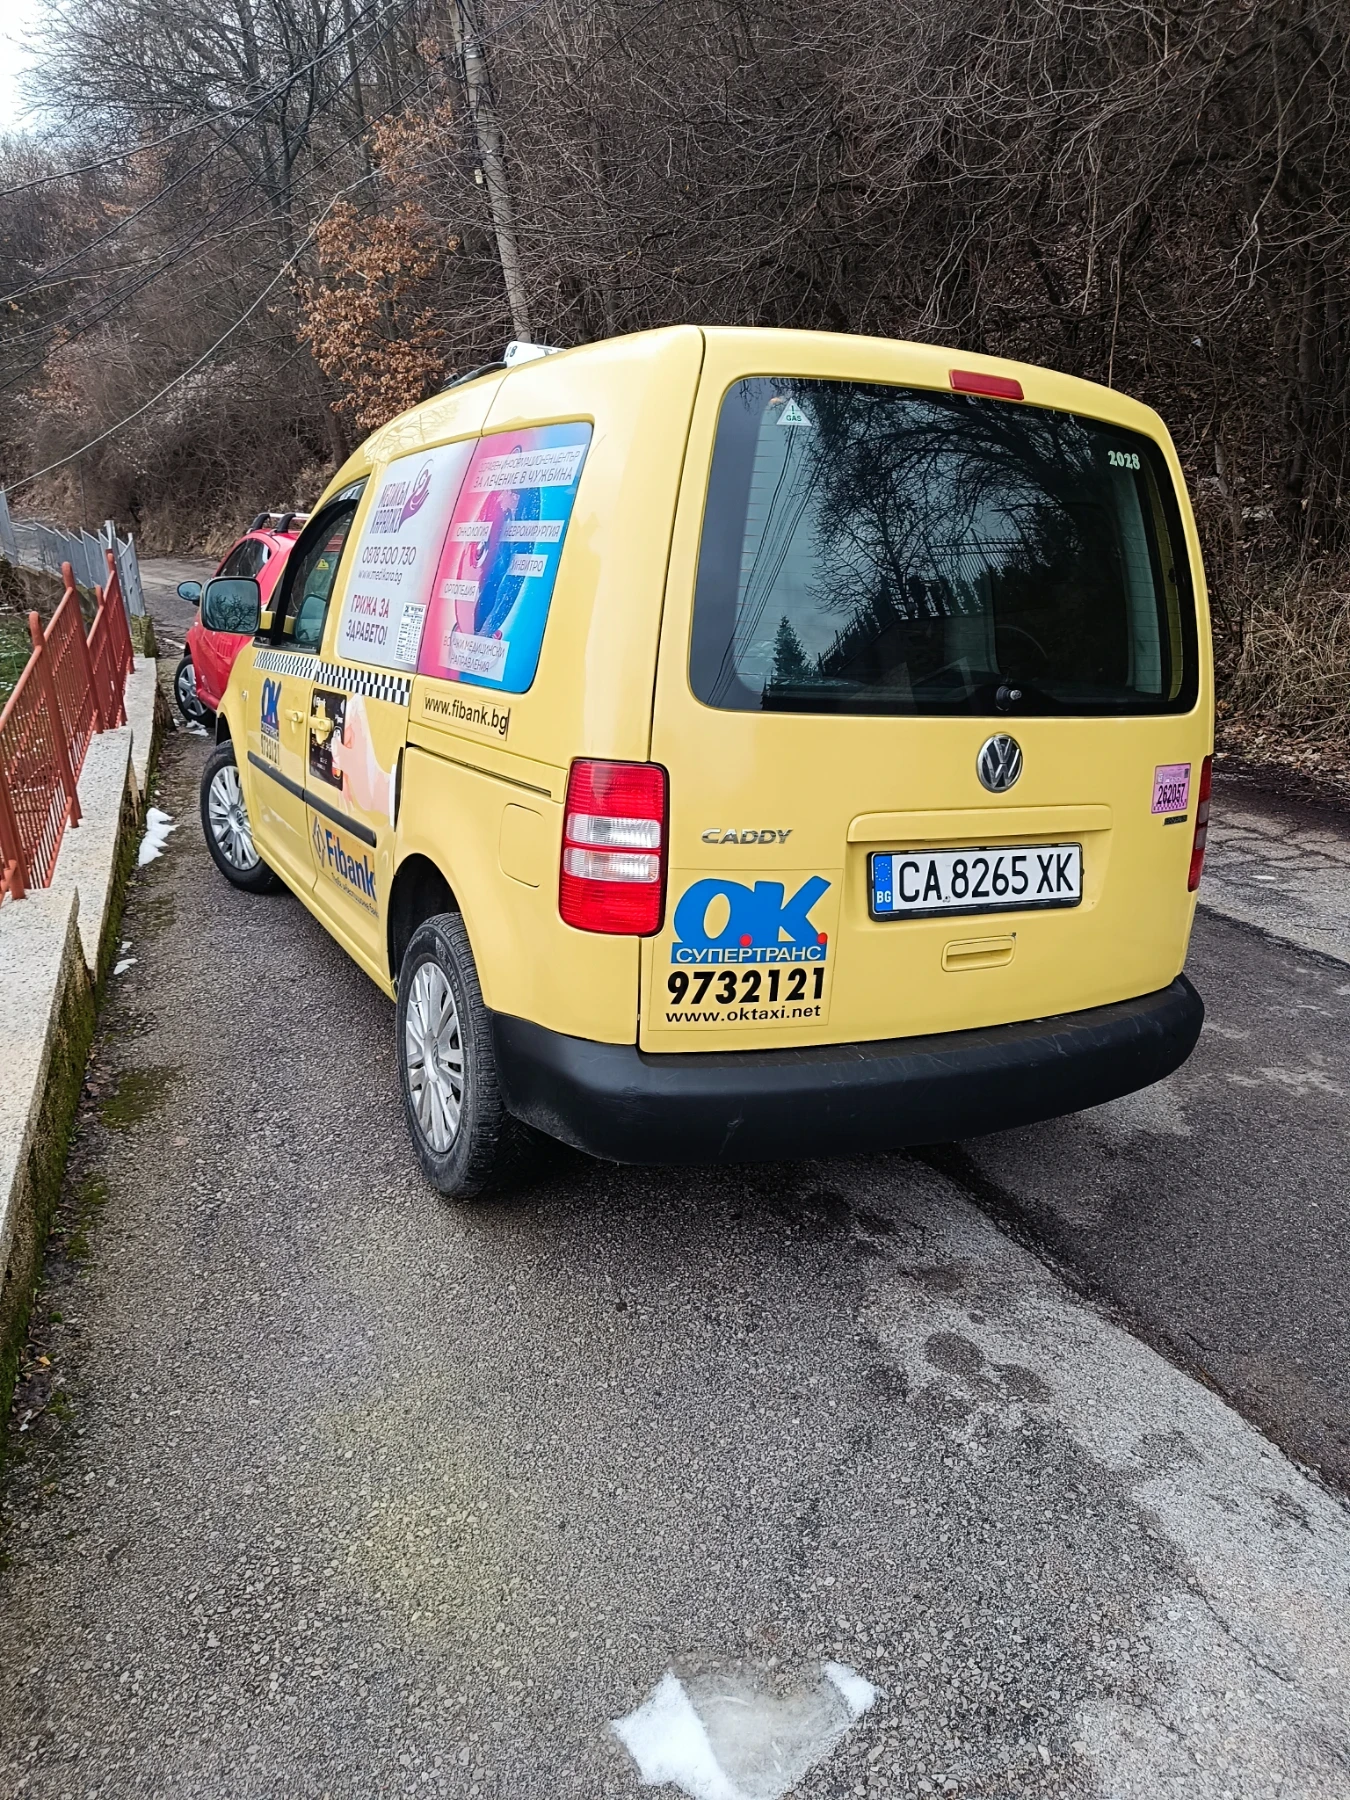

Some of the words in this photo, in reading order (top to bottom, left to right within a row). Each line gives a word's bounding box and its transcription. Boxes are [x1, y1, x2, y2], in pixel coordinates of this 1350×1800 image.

[786, 414, 802, 422] GAS
[1107, 450, 1141, 470] 2028
[473, 476, 482, 488] ЗА
[483, 472, 520, 487] ЛЕЧЕНИЕ
[519, 471, 527, 484] В
[528, 467, 574, 484] ЧУЖБИНА
[504, 525, 561, 537] НЕВРОХИРУРГИЯ
[380, 546, 399, 565] 500
[398, 547, 417, 565] 730
[511, 560, 544, 572] ИНВИТРО
[444, 583, 476, 596] ОРТОПЕДИЯ
[351, 594, 378, 617] ГРИЖА
[379, 598, 390, 618] ЗА
[346, 619, 388, 646] ЗДРАВЕТО!
[424, 696, 509, 735] www.fibank.bg
[1156, 782, 1186, 805] 262057
[701, 828, 793, 844] CADDY
[325, 828, 378, 903] Fibank
[899, 860, 943, 902] CA
[951, 856, 1029, 899] 8265
[1036, 853, 1074, 893] XK
[876, 890, 892, 904] BG
[676, 945, 822, 963] СУПЕРТРАНС
[667, 967, 825, 1005] 9732121
[665, 1004, 821, 1022] www.oktaxi.net
